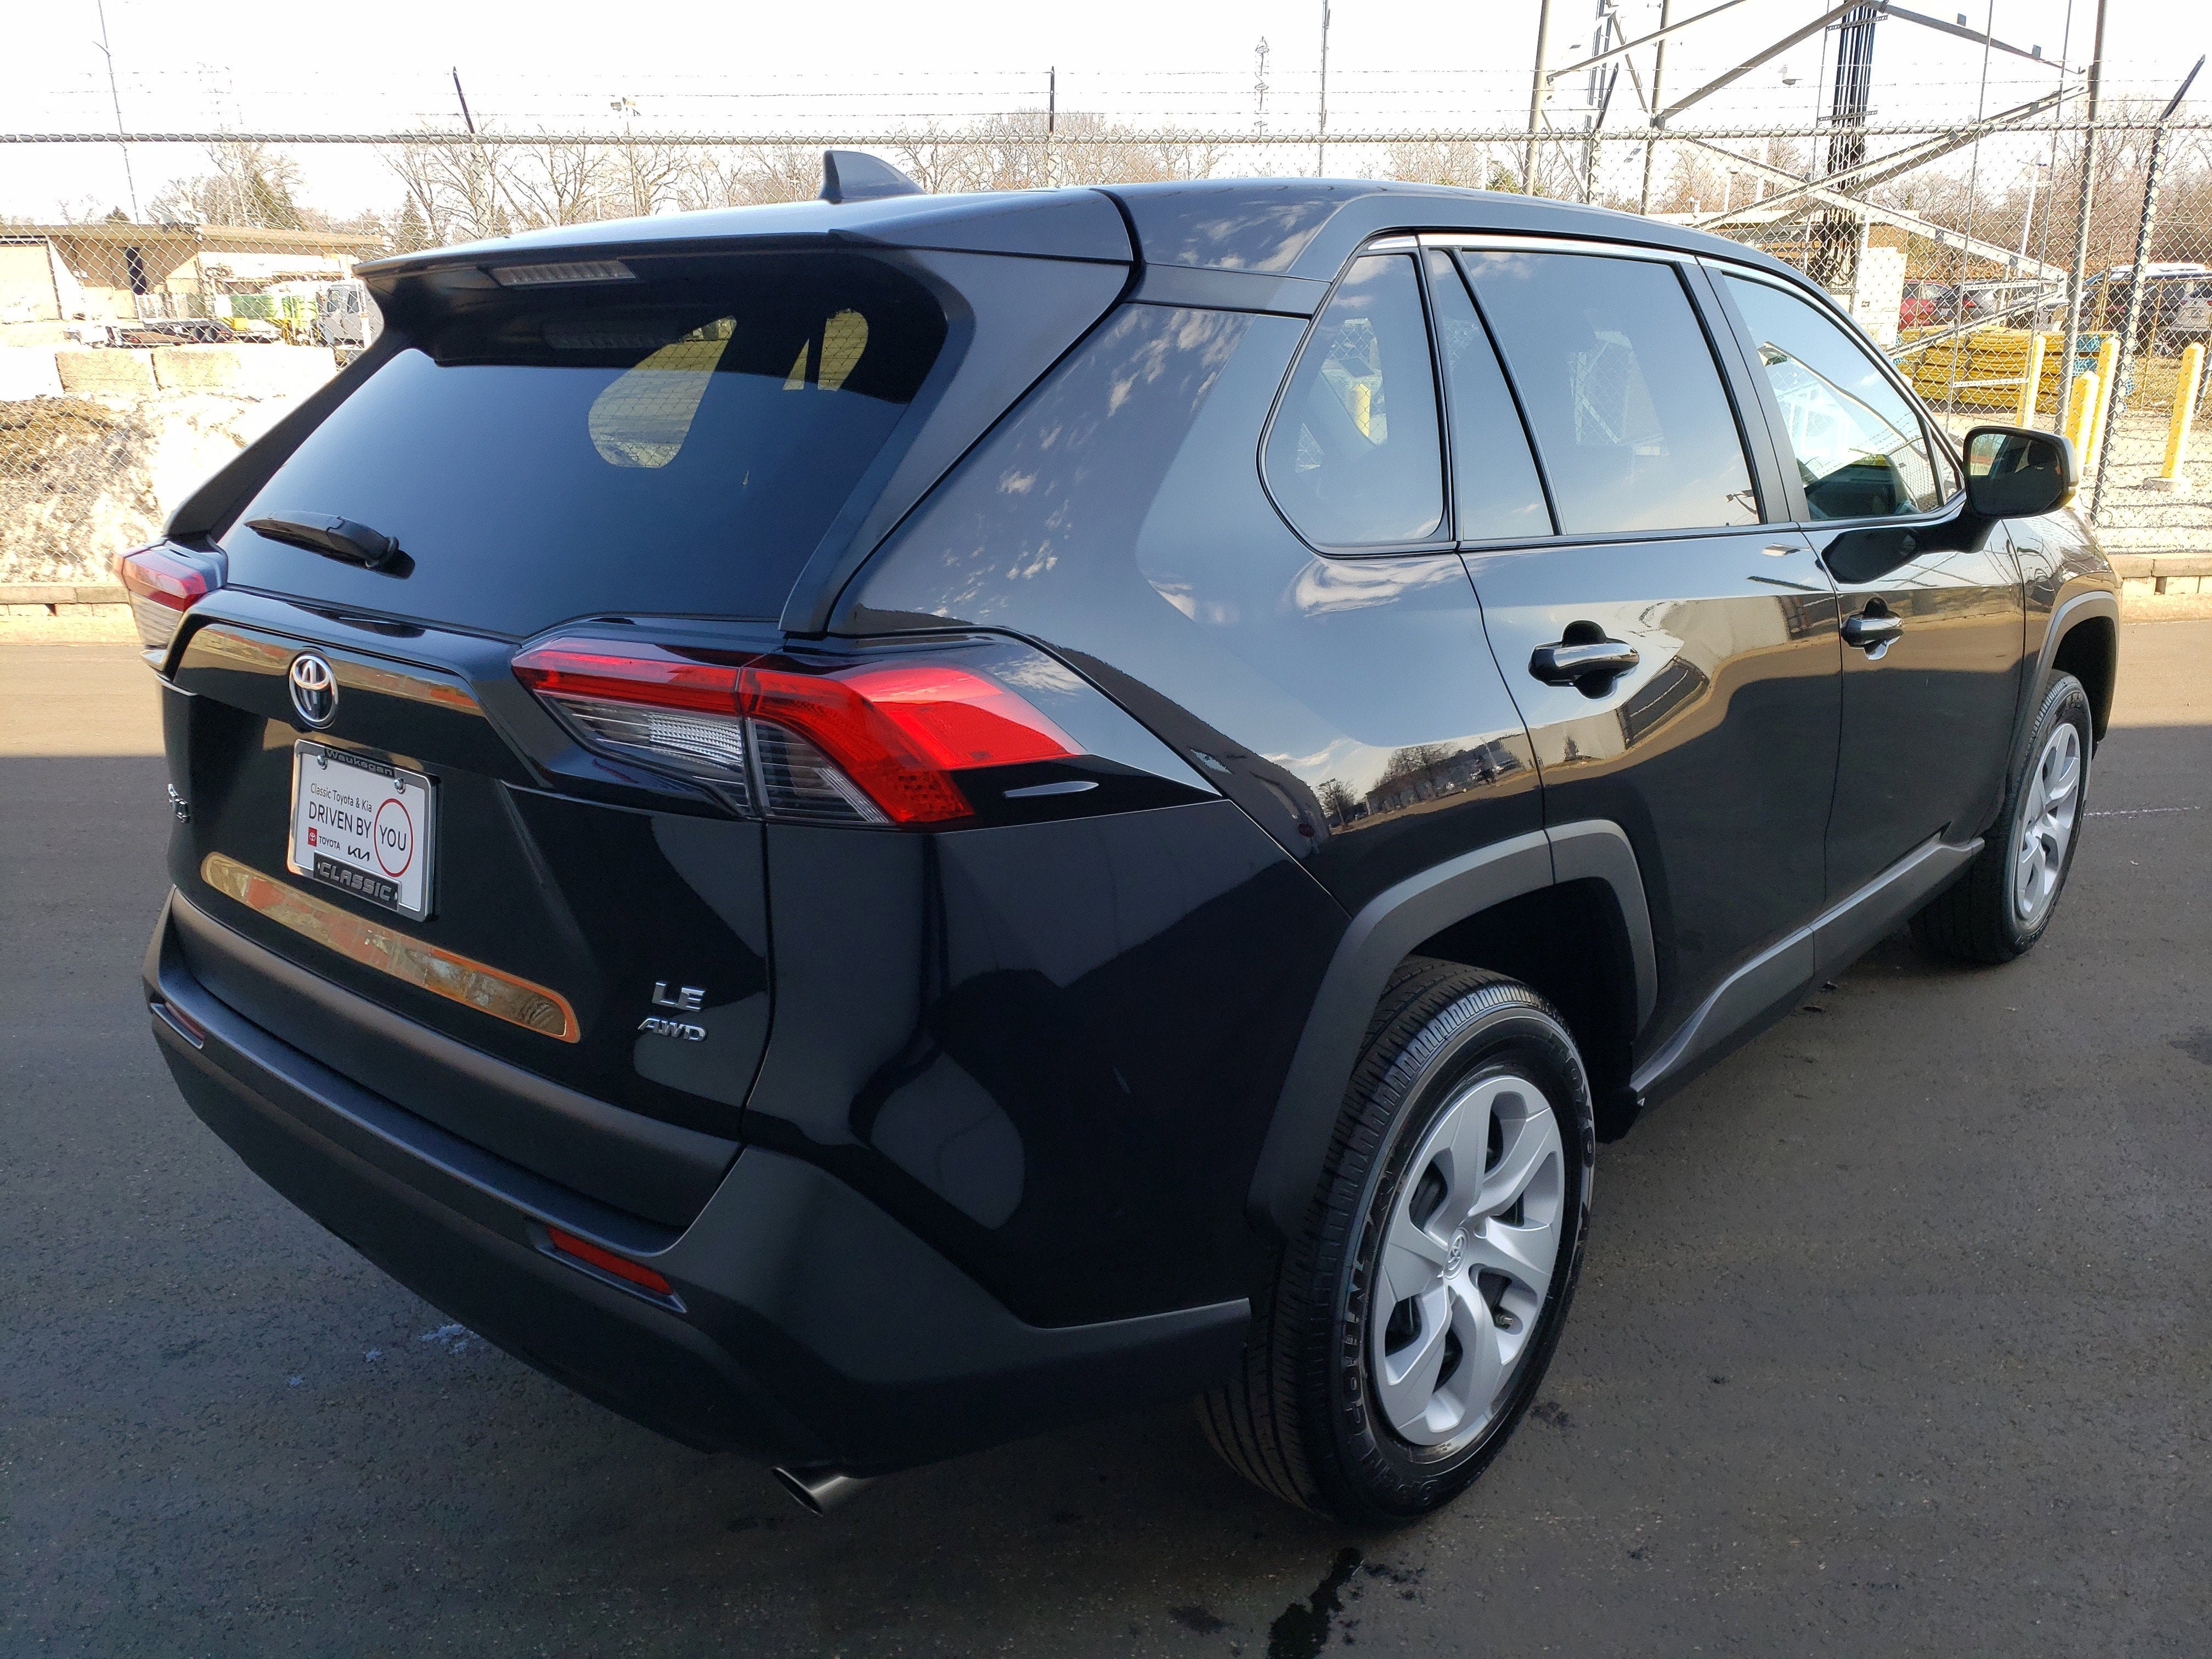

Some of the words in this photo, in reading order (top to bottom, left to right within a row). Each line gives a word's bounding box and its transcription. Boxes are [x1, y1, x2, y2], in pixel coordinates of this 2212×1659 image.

[326, 749, 392, 776] Waukegan
[311, 782, 331, 799] Classic
[332, 789, 354, 807] Toyota
[356, 798, 360, 809] &
[362, 799, 373, 813] Kia
[308, 801, 353, 833] DRIVEN
[357, 817, 372, 839] BY
[379, 824, 407, 851] YOU
[318, 836, 341, 850] TOYOTA
[319, 862, 393, 902] CLASSIC
[652, 981, 706, 1013] LE
[637, 1017, 707, 1041] AWD
